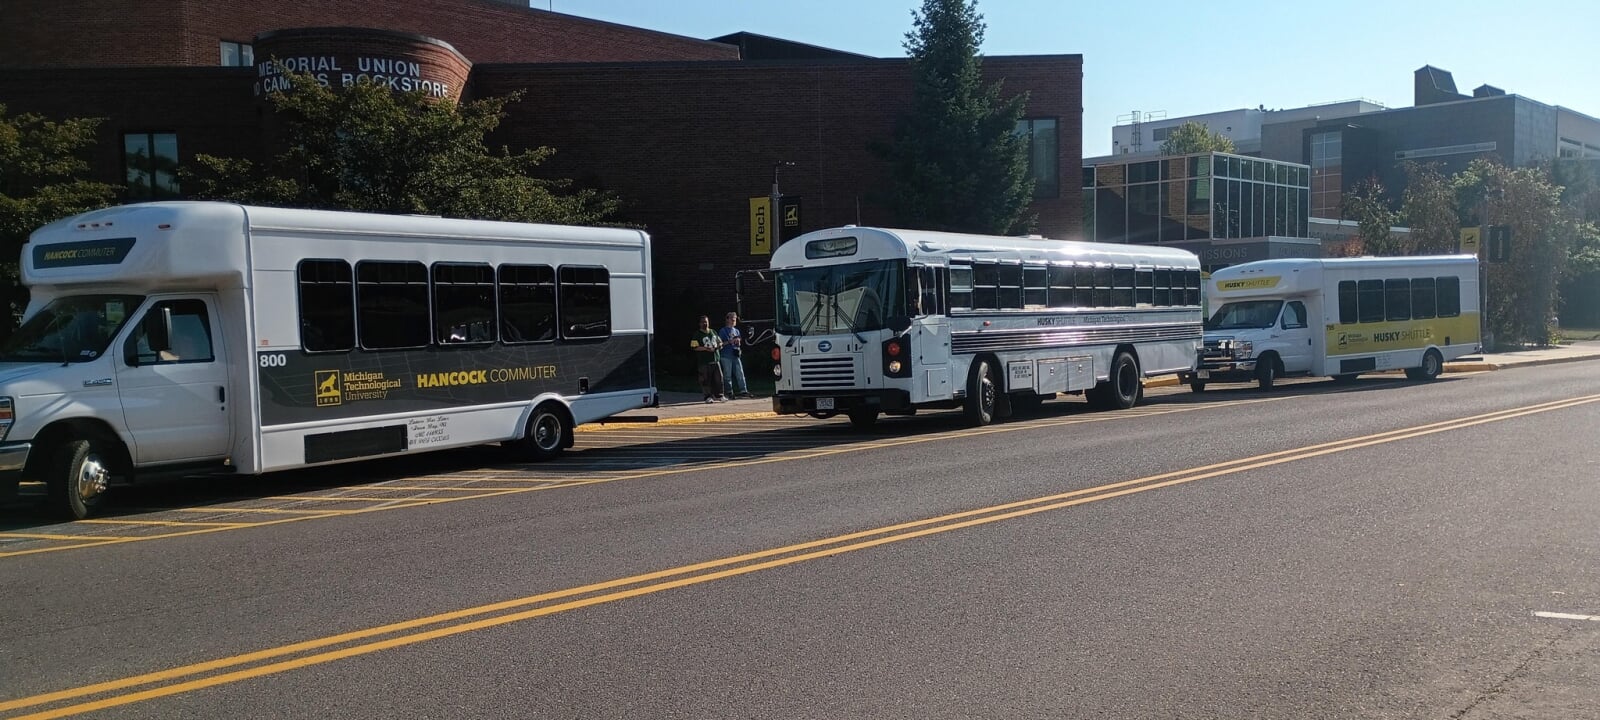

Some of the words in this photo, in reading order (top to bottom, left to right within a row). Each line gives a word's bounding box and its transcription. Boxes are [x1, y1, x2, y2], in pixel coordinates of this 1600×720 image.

[258, 56, 341, 77] MEMORIAL
[358, 57, 420, 77] UNION
[263, 73, 329, 92] CAMS
[341, 73, 449, 98] BOOKSTORE
[756, 206, 765, 247] Tech
[43, 250, 77, 260] HANCOCK
[77, 247, 116, 258] COMMUTER
[1037, 317, 1056, 326] HUSKY
[1374, 331, 1400, 342] HUSKY
[1401, 328, 1431, 340] SHUTTLE
[260, 354, 287, 367] 800
[343, 371, 383, 382] Michigan
[417, 370, 487, 388] HANCOCK
[490, 365, 557, 383] COMMUTER
[343, 379, 401, 391] Technological
[345, 390, 388, 401] University
